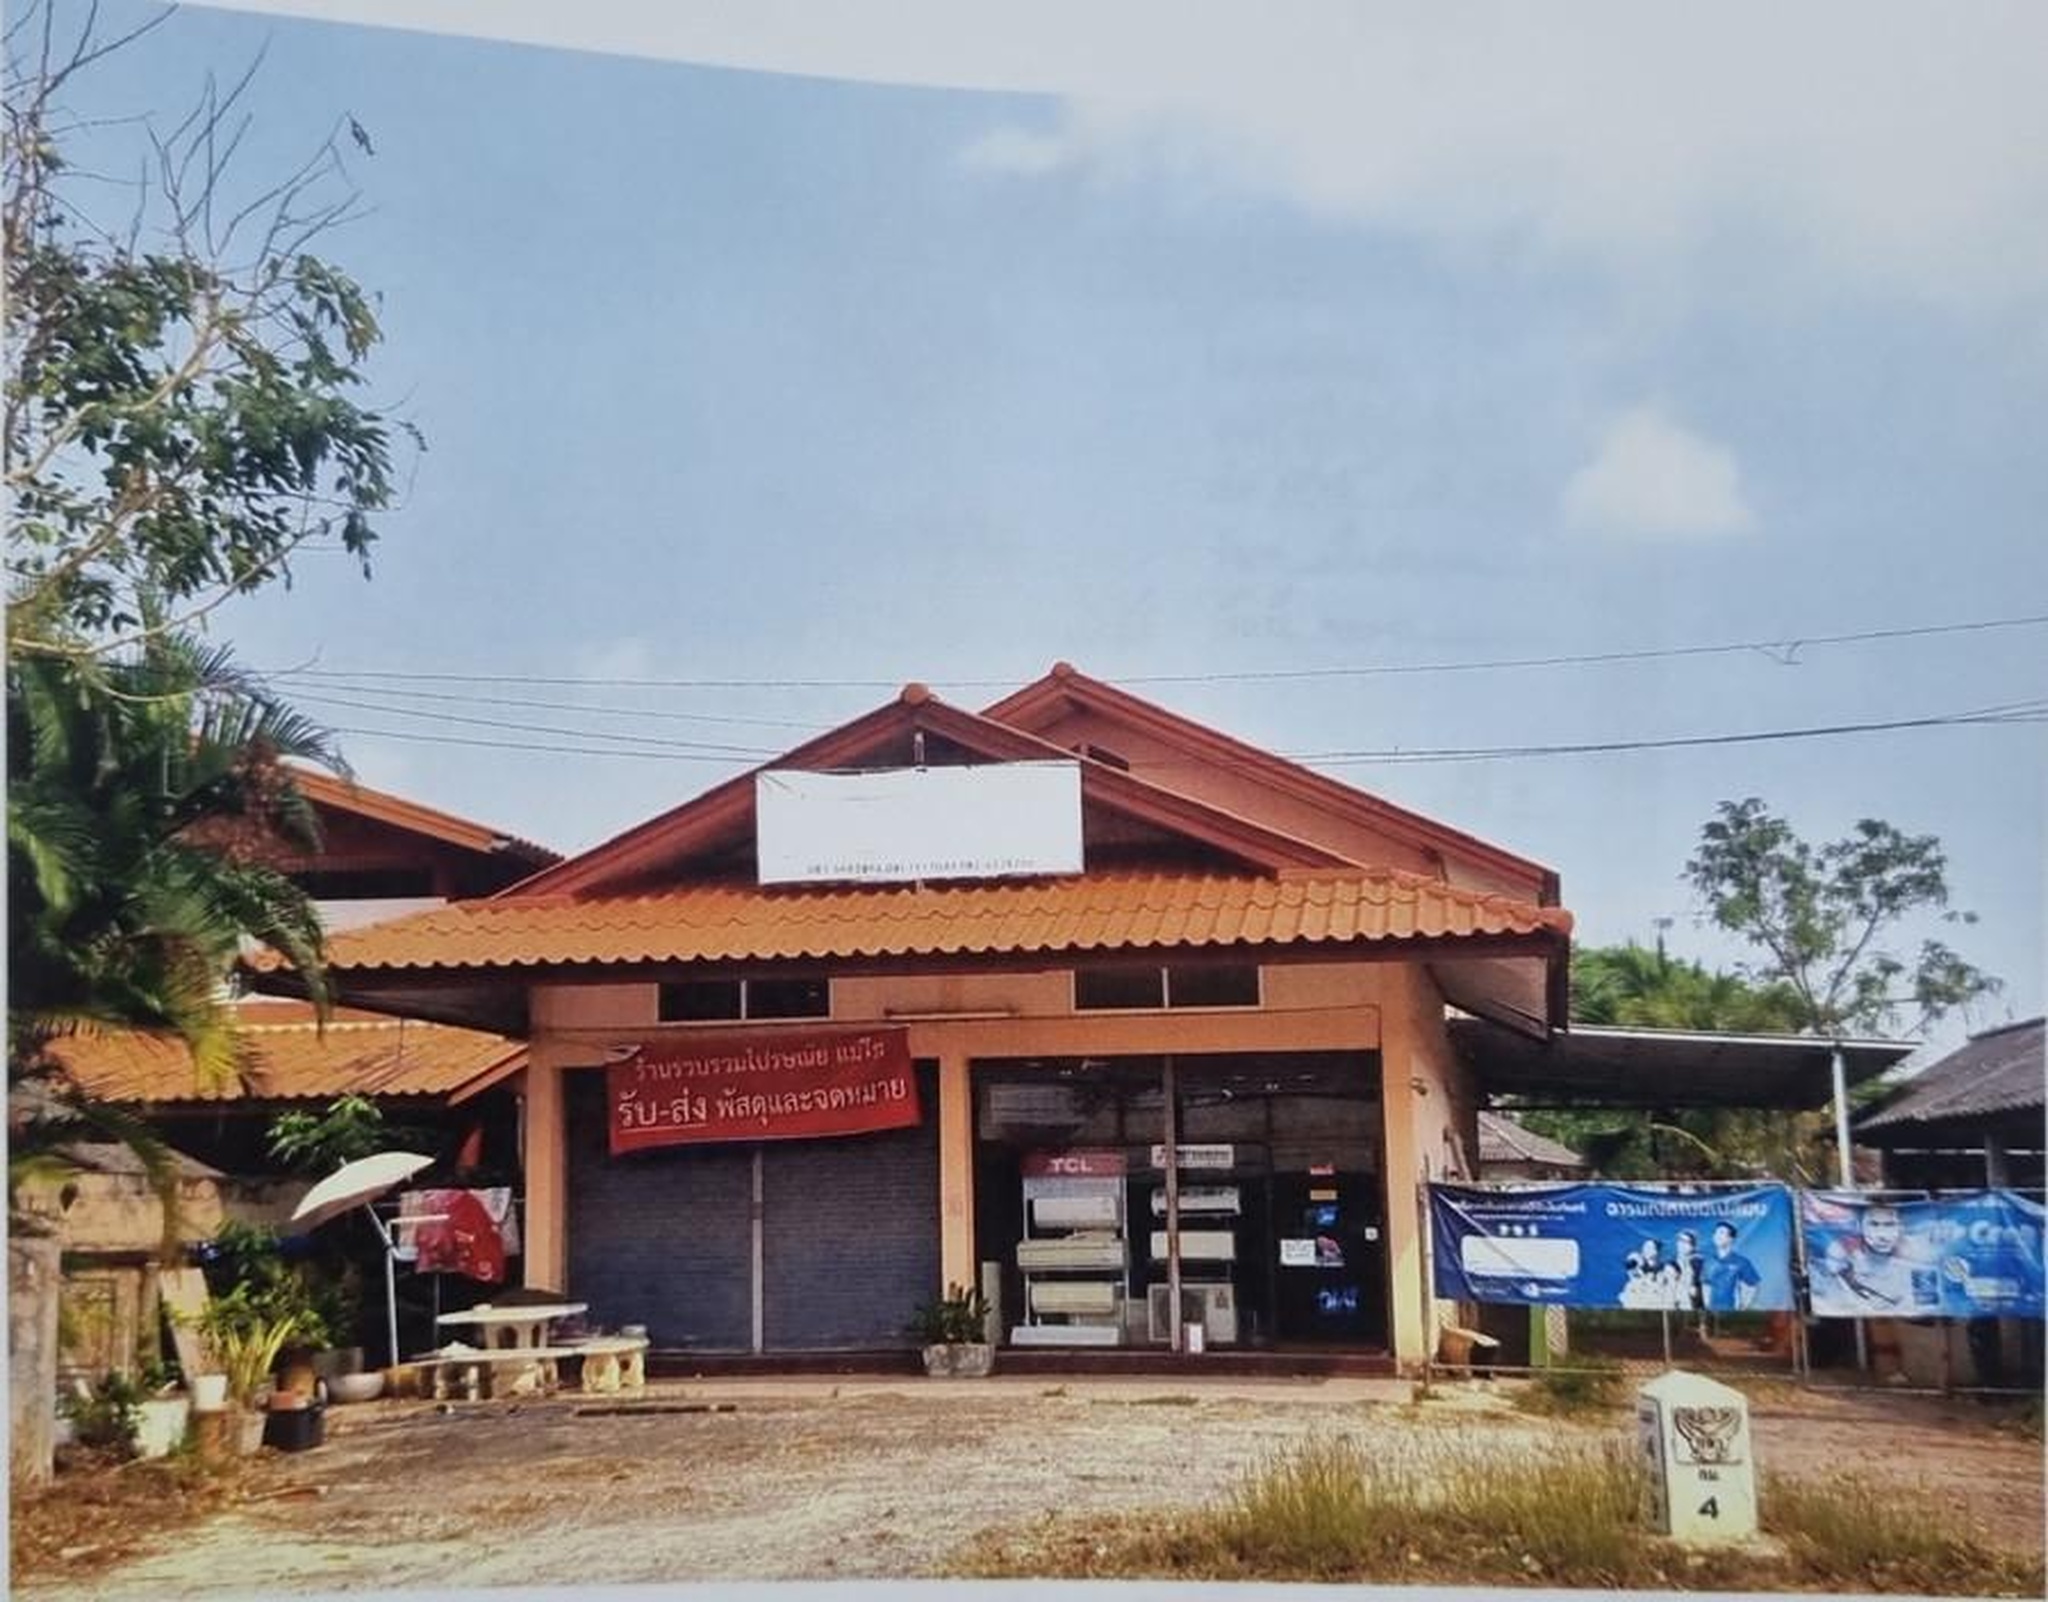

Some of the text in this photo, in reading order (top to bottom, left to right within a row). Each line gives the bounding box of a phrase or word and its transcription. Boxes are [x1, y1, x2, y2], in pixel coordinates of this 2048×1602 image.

[618, 1077, 907, 1127] รับ-ส่ง พัสดุและจดหมาย
[1050, 1157, 1094, 1172] TCL
[1697, 1495, 1719, 1519] 4
